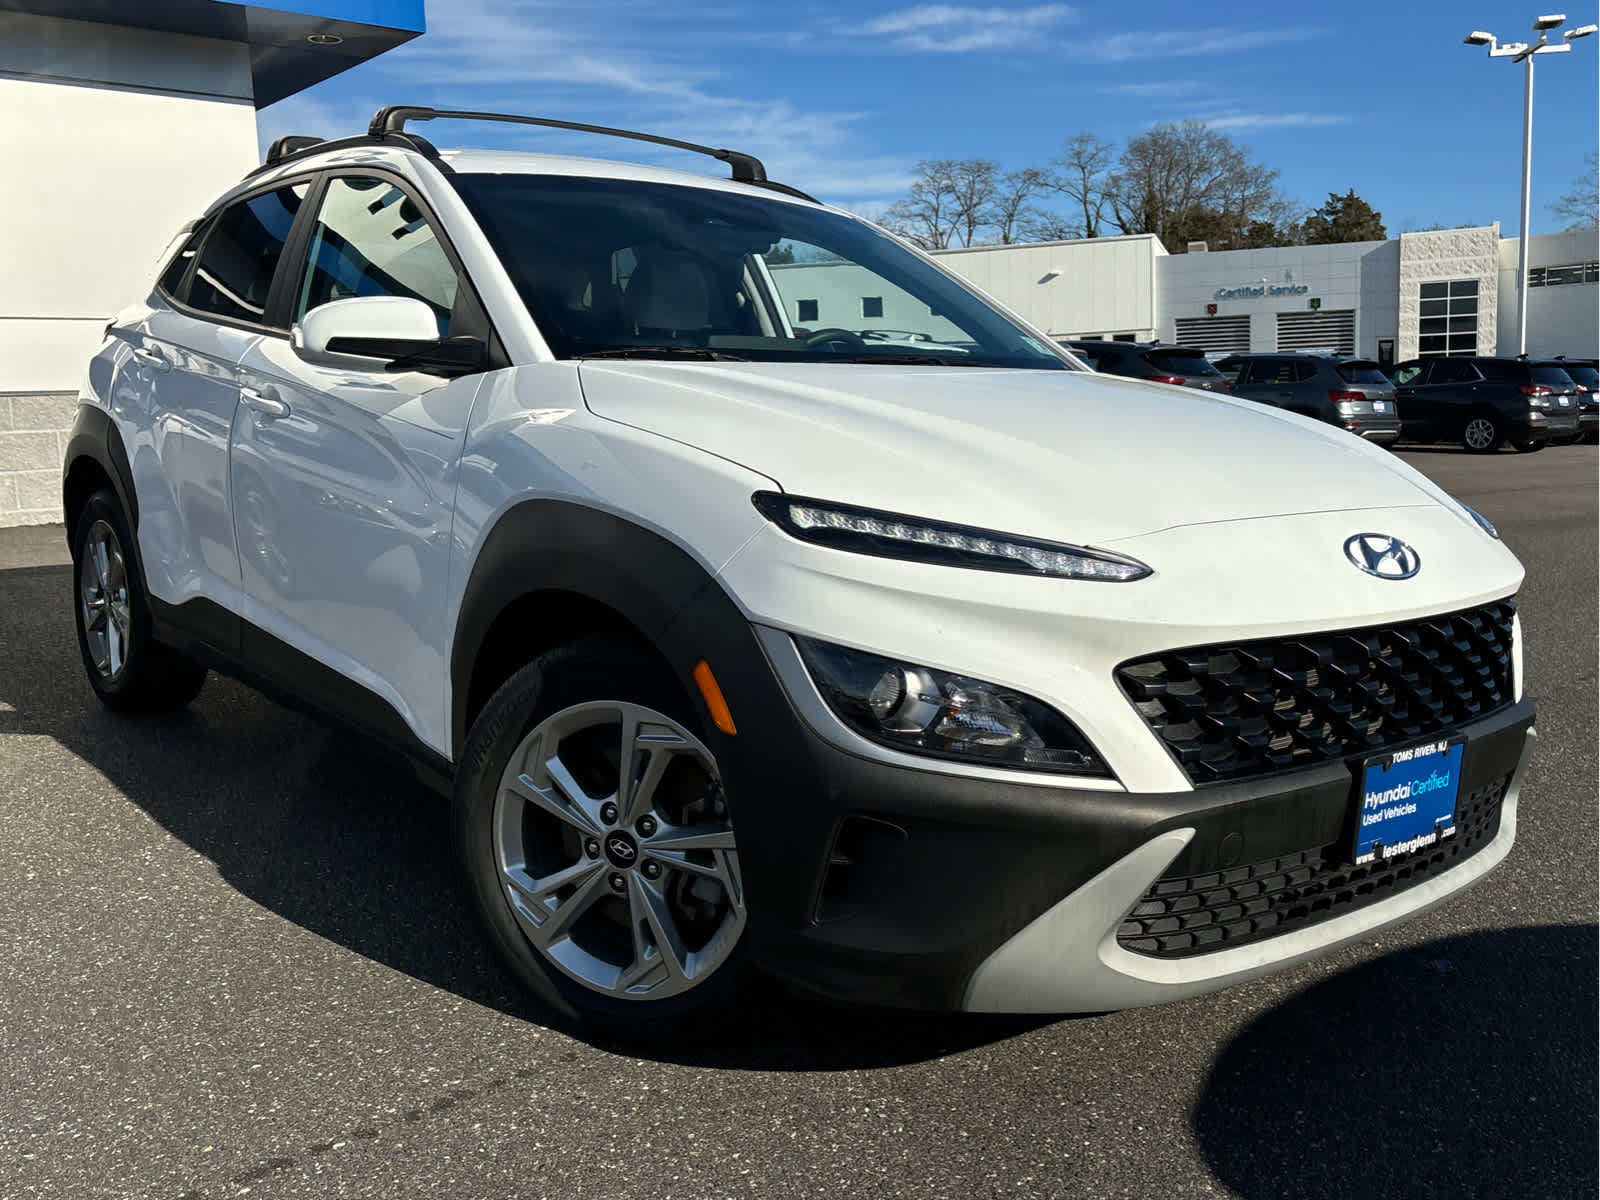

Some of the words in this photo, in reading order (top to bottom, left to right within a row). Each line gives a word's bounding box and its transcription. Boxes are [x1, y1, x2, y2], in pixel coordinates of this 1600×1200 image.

[1392, 749, 1413, 763] TOMS
[1437, 740, 1448, 752] NJ
[1364, 781, 1411, 810] Hyundai
[1411, 769, 1450, 796] Certified
[1362, 809, 1383, 826] Used
[1384, 803, 1417, 820] Vehicles
